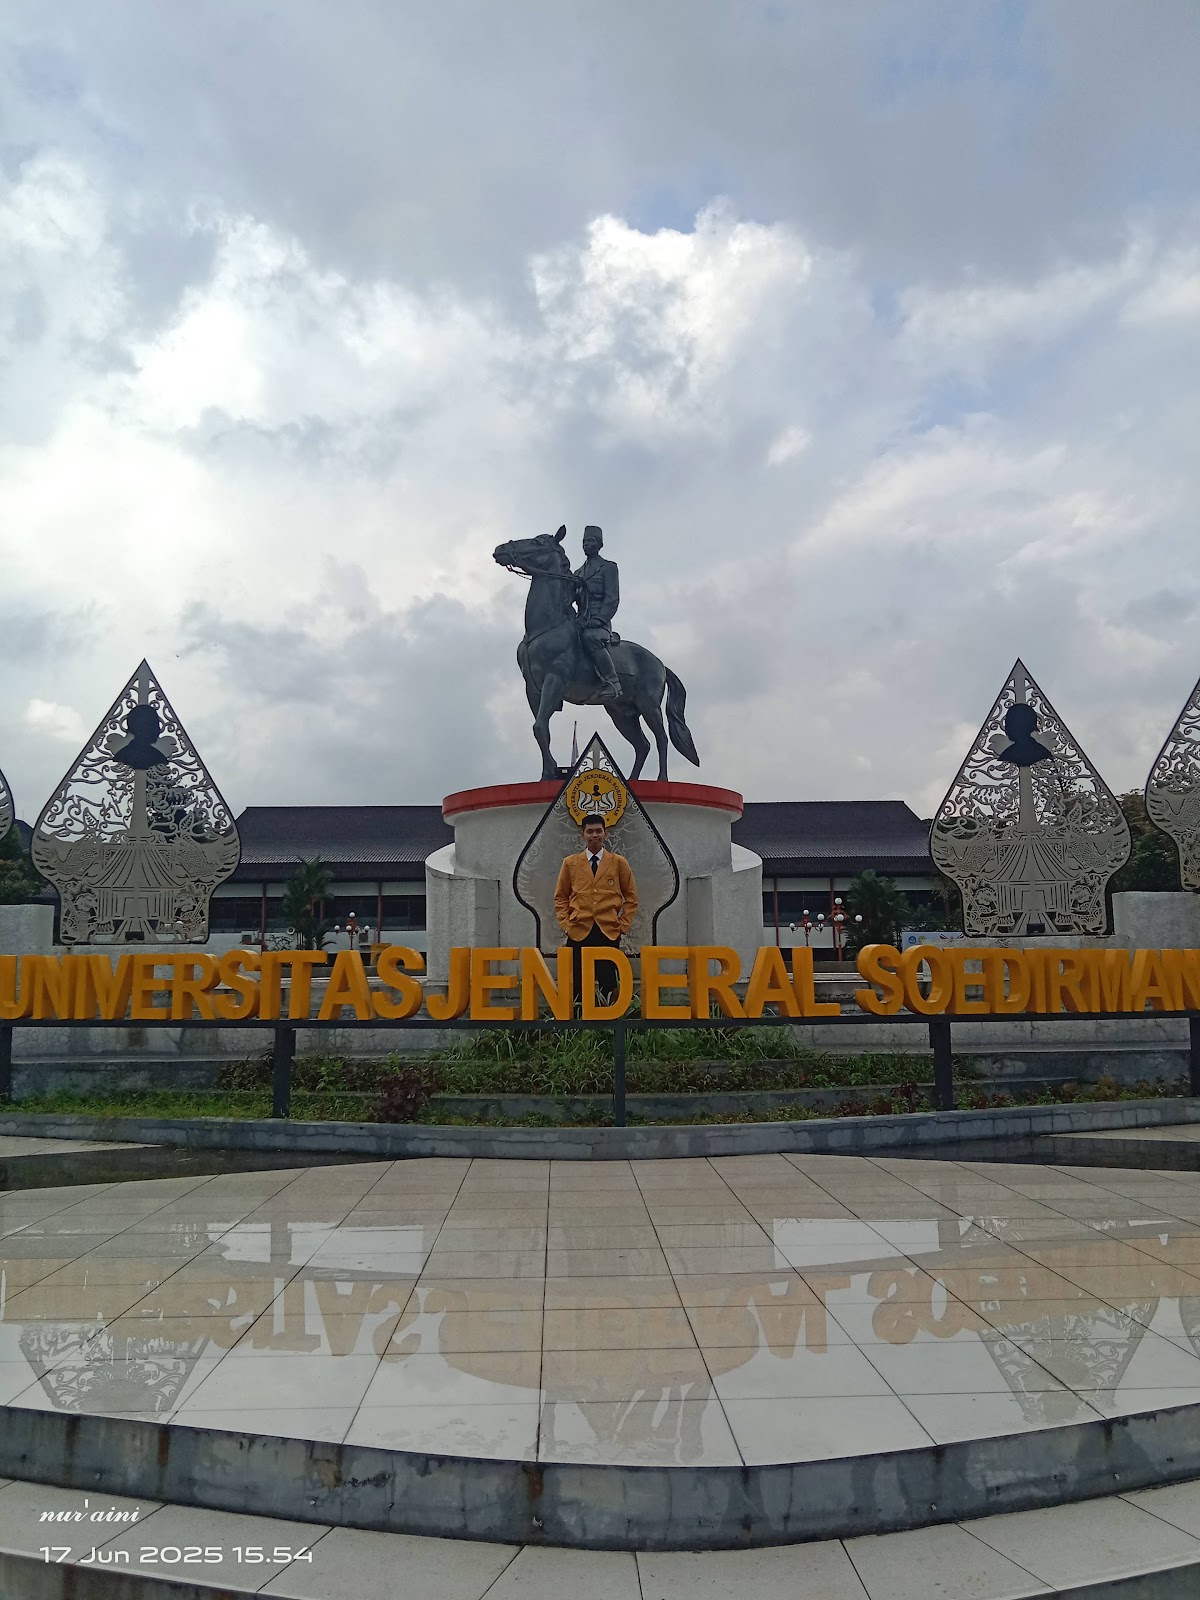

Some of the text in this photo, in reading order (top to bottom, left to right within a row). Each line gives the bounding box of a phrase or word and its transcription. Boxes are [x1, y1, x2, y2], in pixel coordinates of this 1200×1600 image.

[0, 943, 1200, 1021] UNIVERSITAS JENDERAL SOEDIRMAN
